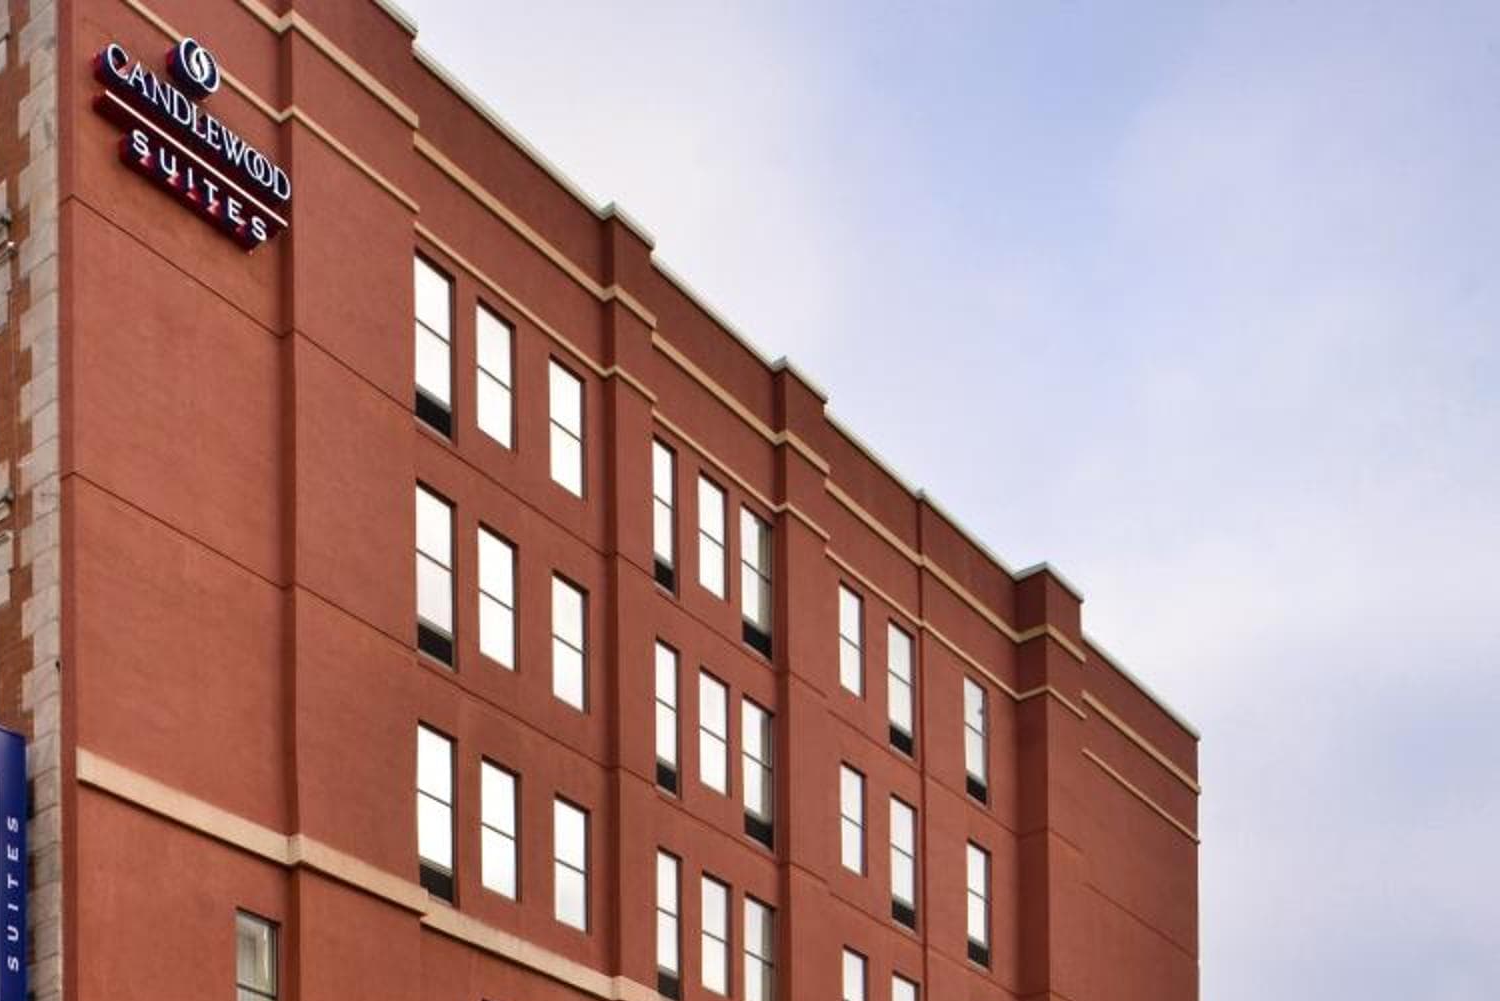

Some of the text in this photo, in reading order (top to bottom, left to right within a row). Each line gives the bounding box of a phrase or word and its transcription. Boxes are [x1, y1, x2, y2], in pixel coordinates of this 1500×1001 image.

[107, 43, 291, 200] CANDLEWOOD
[132, 129, 267, 241] SUITES
[7, 816, 19, 972] SUITES
